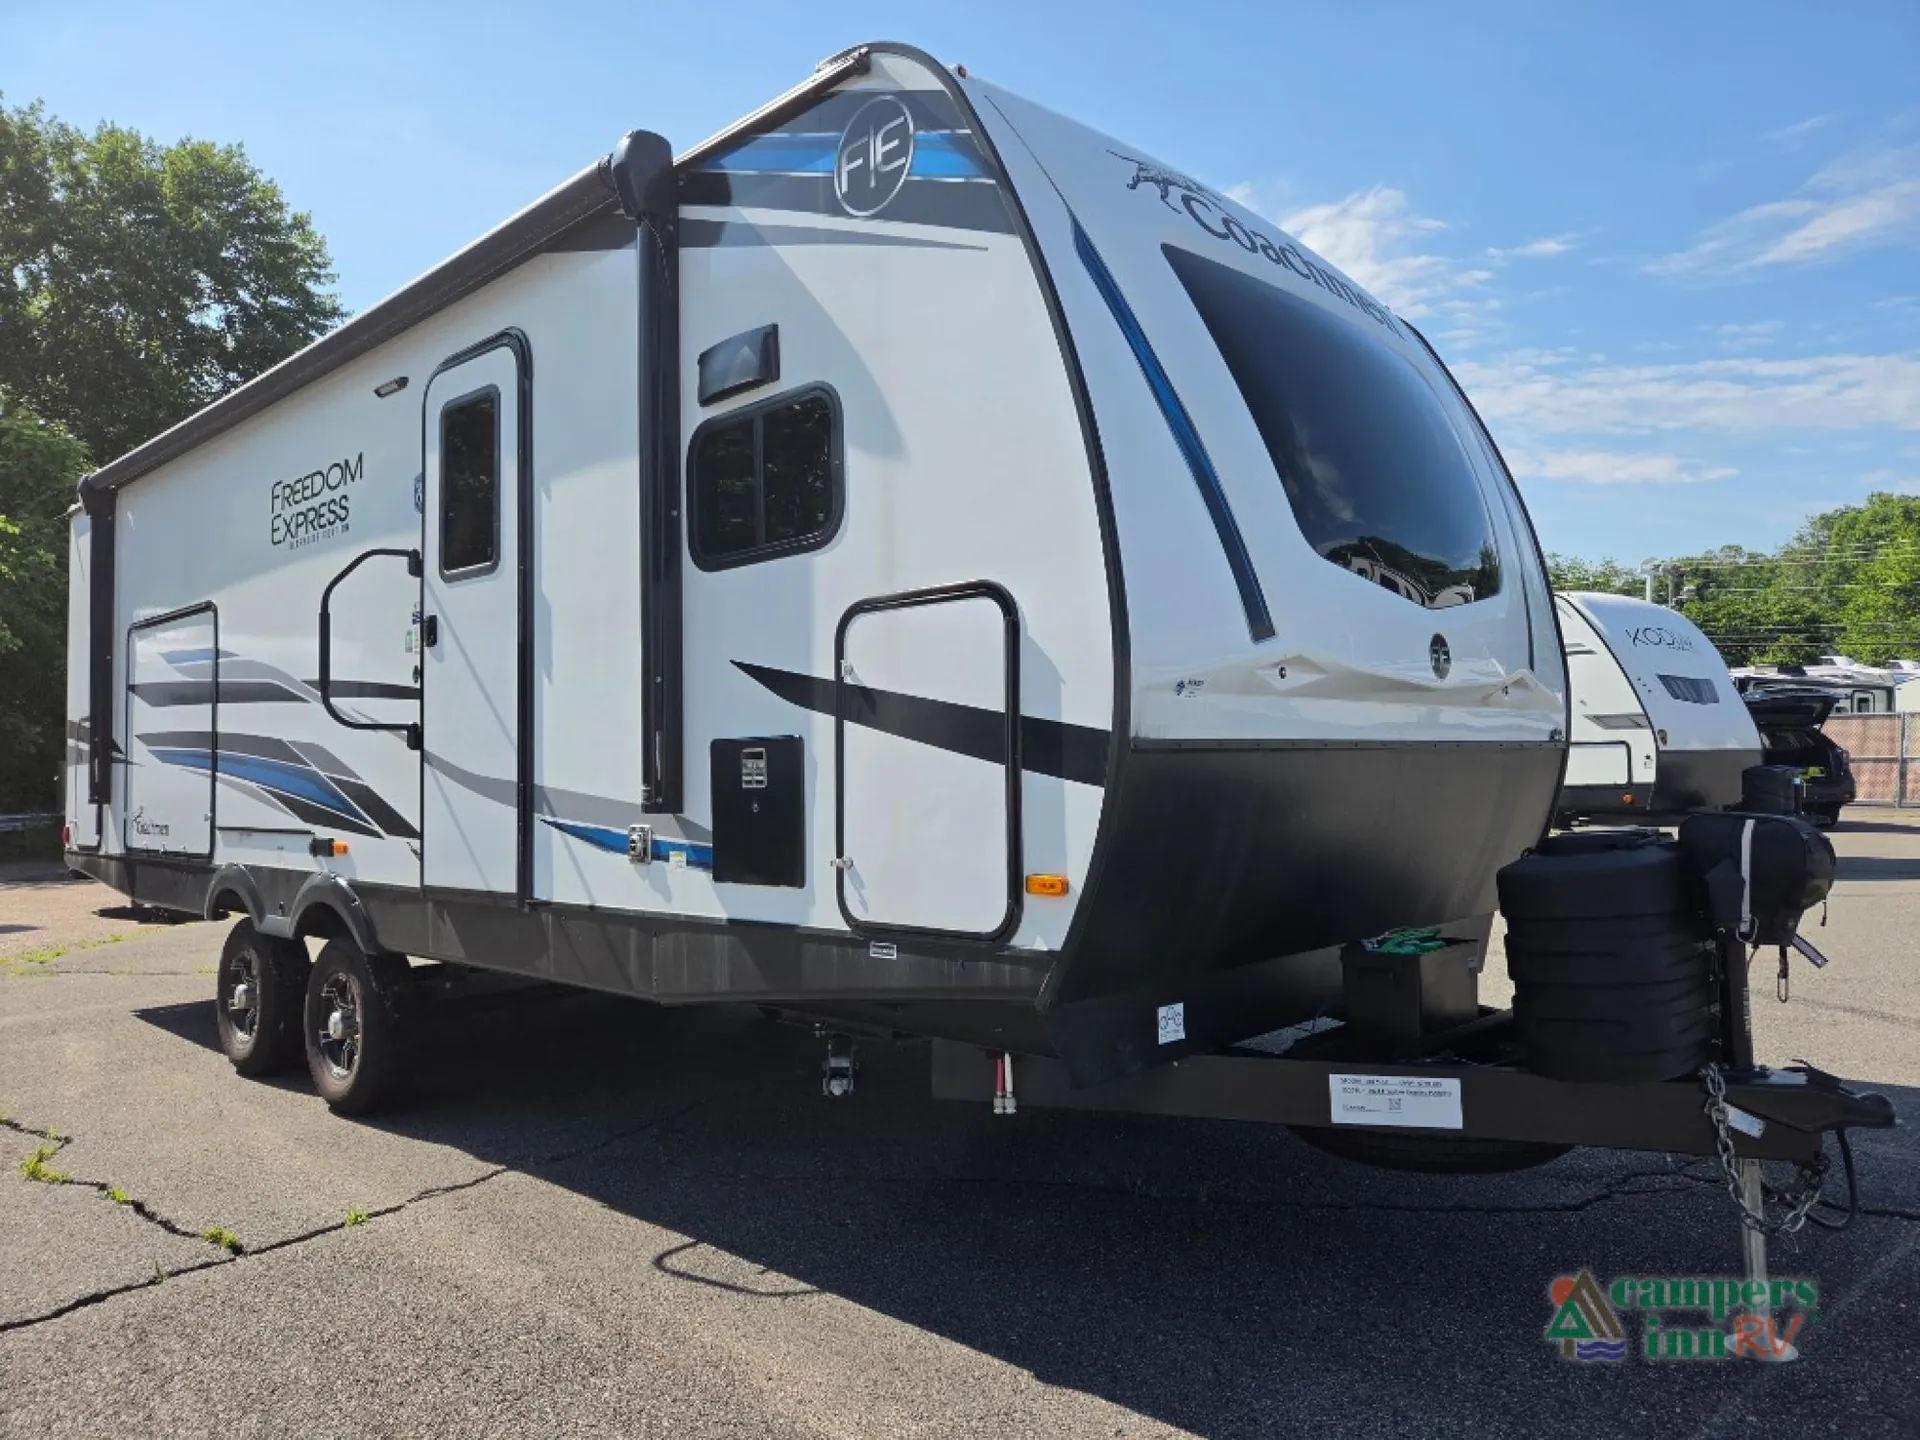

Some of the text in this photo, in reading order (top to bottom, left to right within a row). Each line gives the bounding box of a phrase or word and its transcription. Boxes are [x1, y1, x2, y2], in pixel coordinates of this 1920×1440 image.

[1181, 194, 1406, 342] Coachmen
[271, 451, 363, 514] FREEDOM
[271, 494, 349, 546] EXPRESS
